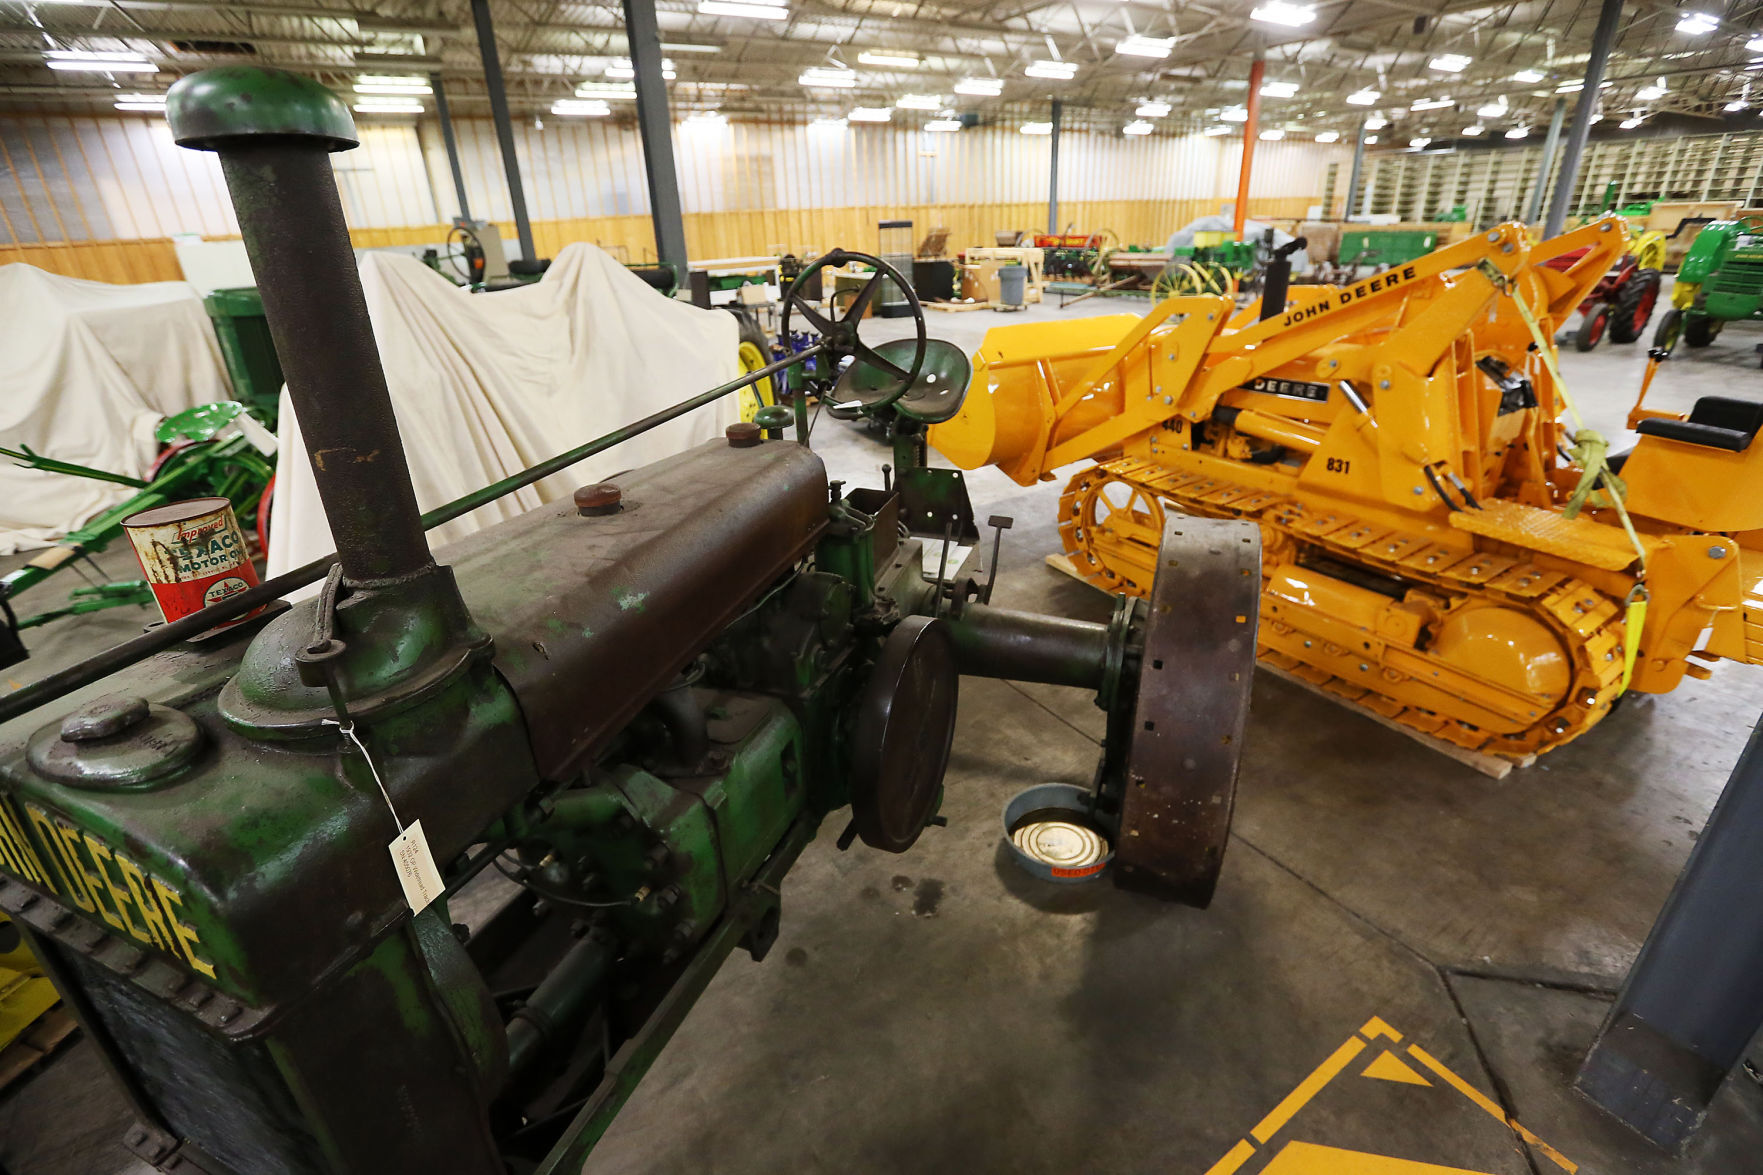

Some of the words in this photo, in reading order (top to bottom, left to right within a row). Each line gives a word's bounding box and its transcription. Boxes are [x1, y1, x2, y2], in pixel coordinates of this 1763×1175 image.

[1284, 300, 1331, 327] JOHN
[1339, 266, 1417, 305] DEERE
[1254, 378, 1318, 398] DEERE
[1162, 419, 1183, 434] 440
[1327, 457, 1350, 474] 831
[176, 515, 224, 543] Improved
[178, 554, 228, 574] MOTOR
[208, 581, 244, 597] TEXACO
[24, 803, 217, 980] DEERE
